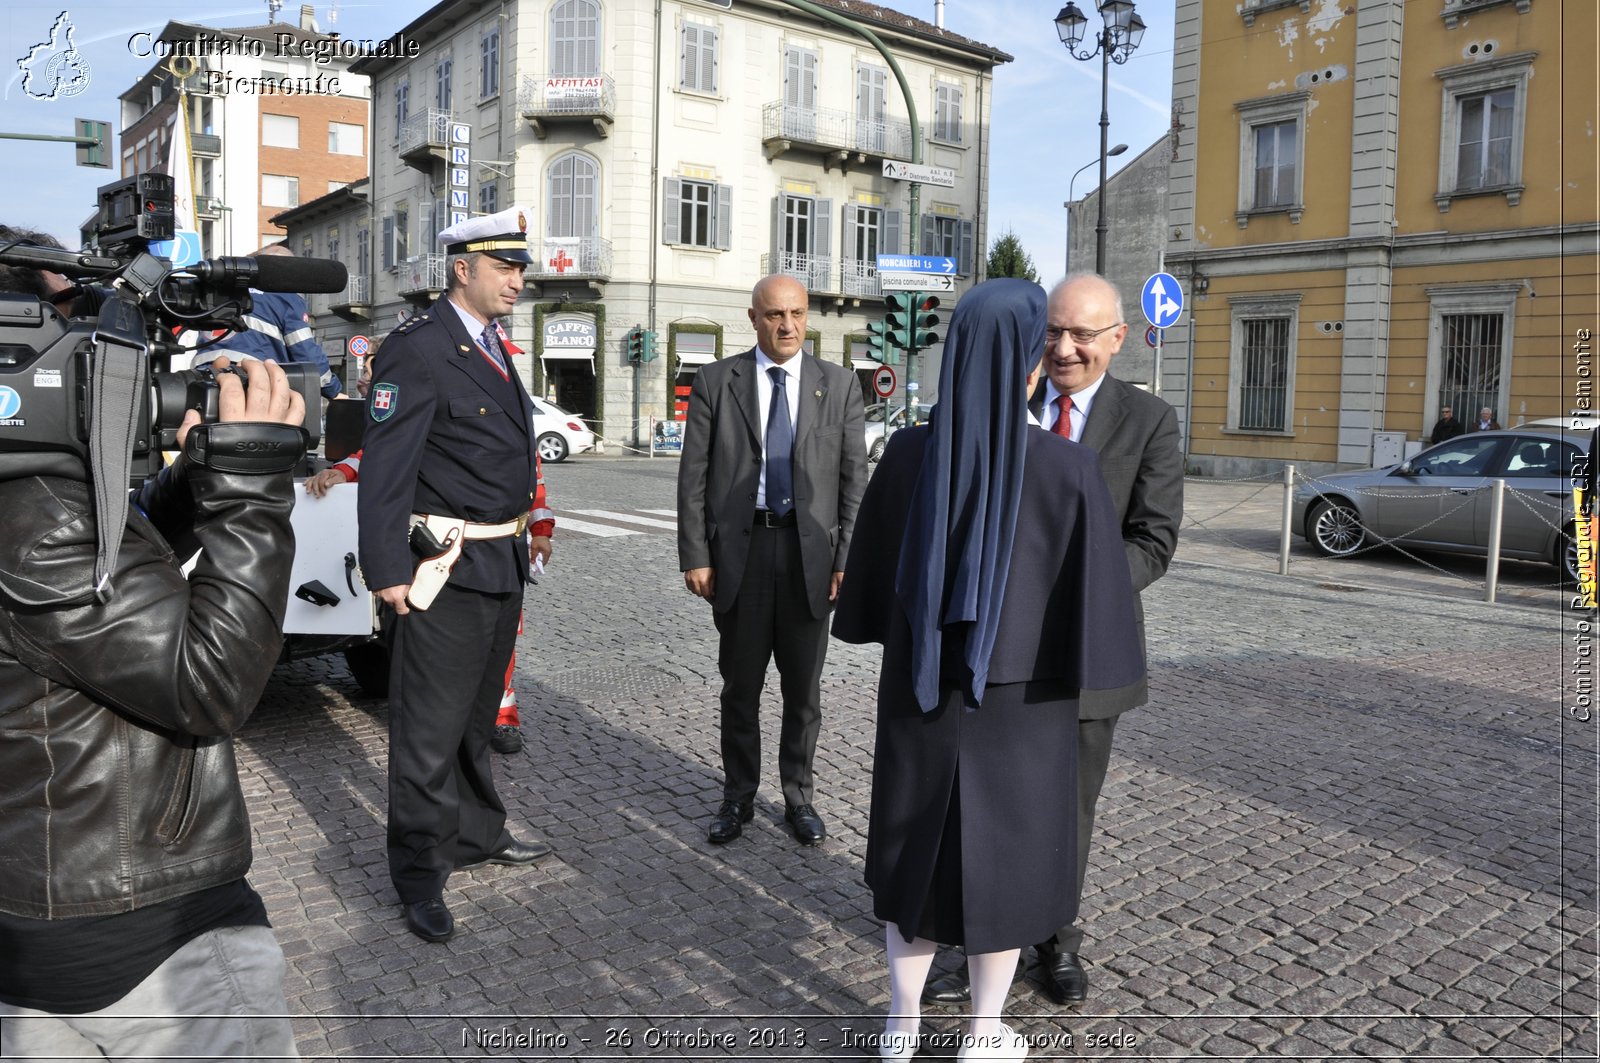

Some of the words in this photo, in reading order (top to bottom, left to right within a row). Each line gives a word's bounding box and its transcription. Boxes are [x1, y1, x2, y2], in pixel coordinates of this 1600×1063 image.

[546, 78, 603, 88] AFFITTASI
[909, 173, 931, 182] Distretto
[931, 176, 953, 185] Sanitario
[879, 258, 921, 268] MONCALIERI
[883, 277, 902, 287] piscina
[903, 278, 928, 287] comunale
[545, 335, 595, 347] BLANCO
[235, 440, 282, 452] SONY
